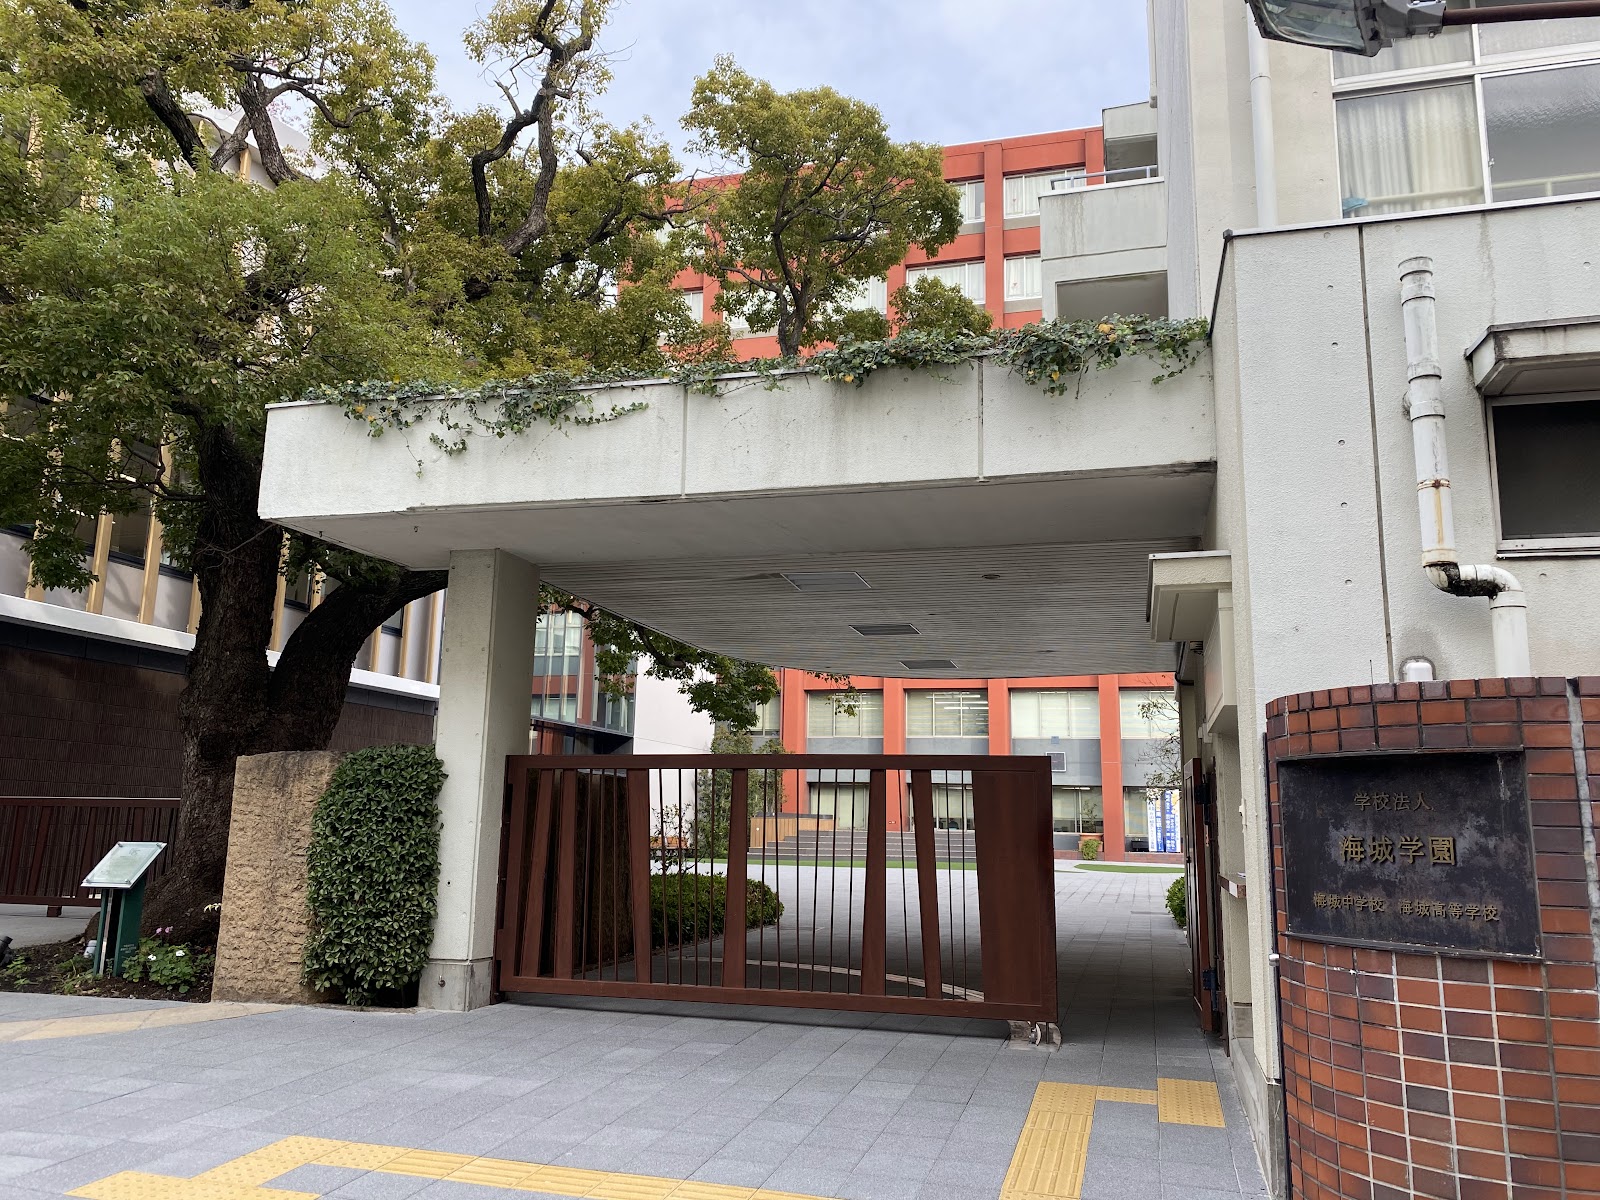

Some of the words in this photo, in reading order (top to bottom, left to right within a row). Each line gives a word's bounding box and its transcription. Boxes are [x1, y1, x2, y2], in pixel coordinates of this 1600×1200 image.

[1353, 791, 1435, 812] 学校法人
[1338, 834, 1456, 866] 海城学園
[1313, 891, 1385, 912] 海城中学校
[1399, 898, 1500, 922] 海城高等学校
